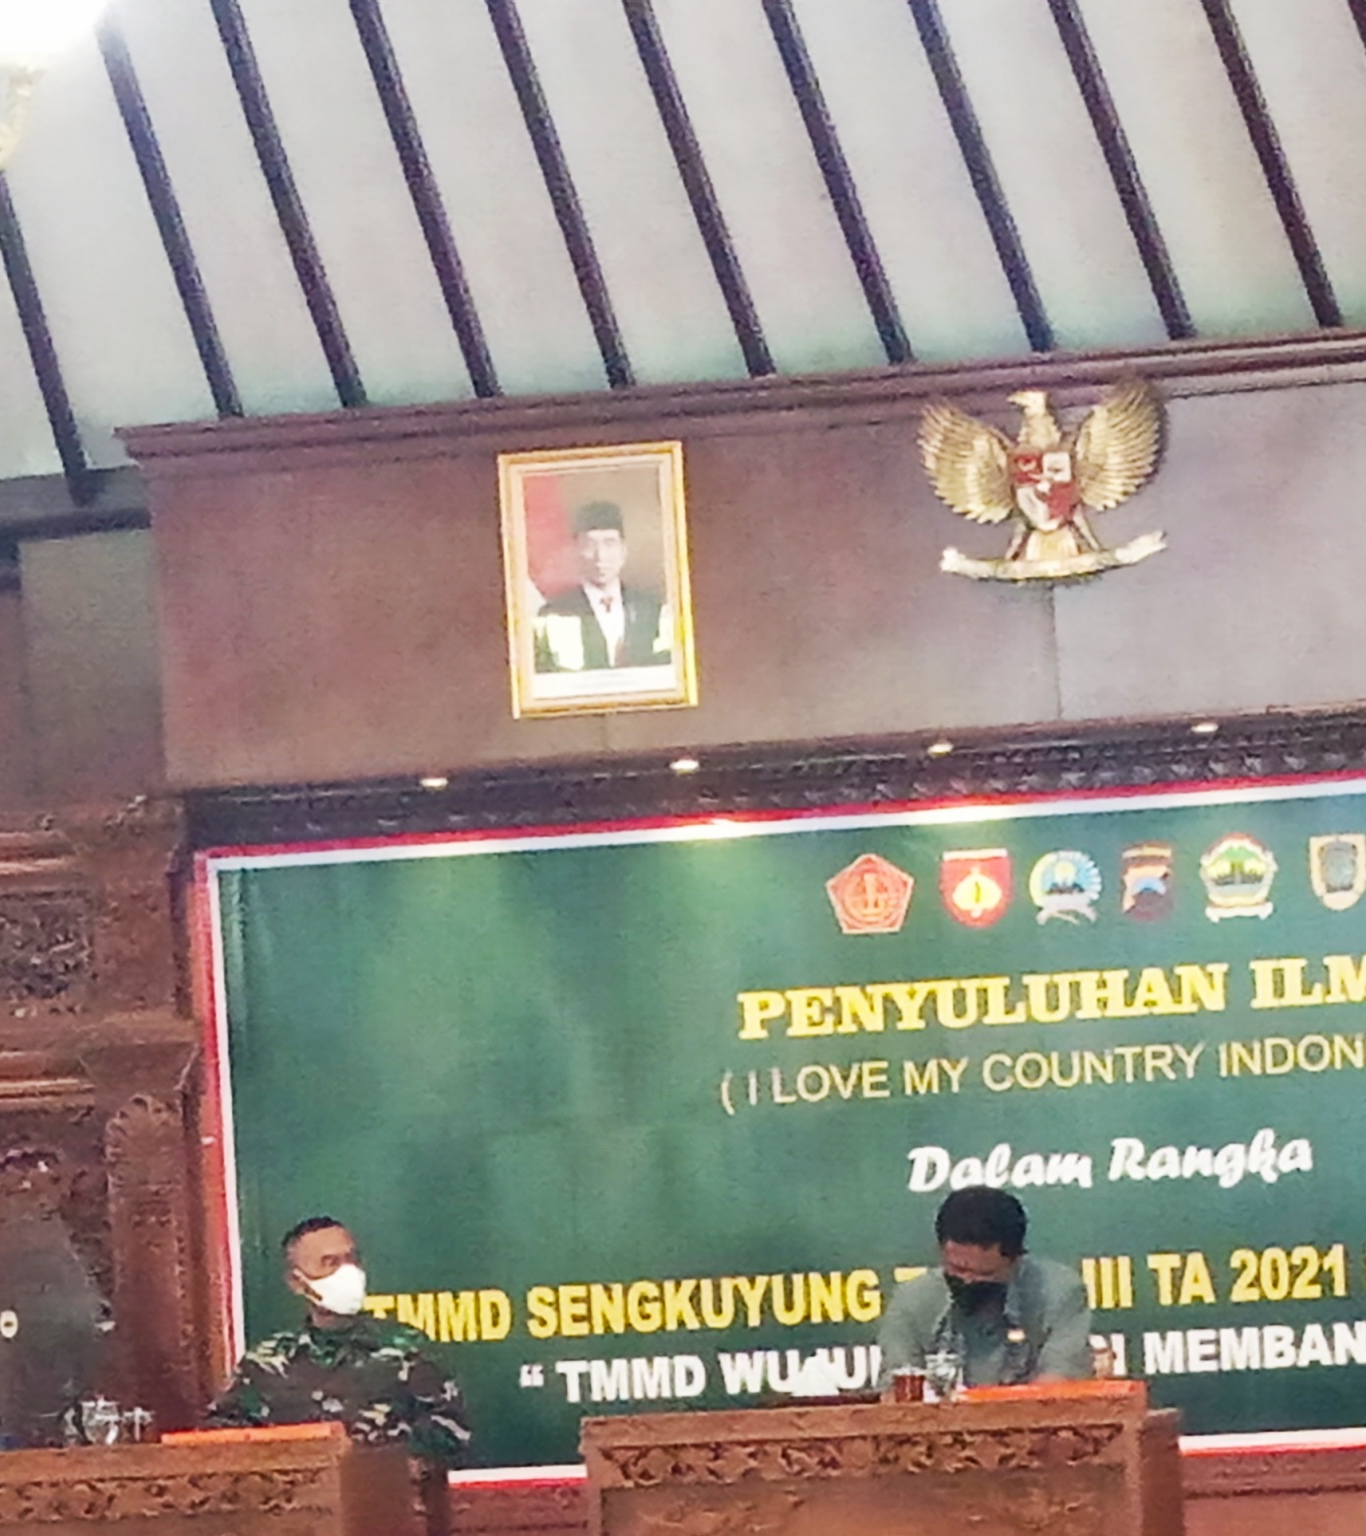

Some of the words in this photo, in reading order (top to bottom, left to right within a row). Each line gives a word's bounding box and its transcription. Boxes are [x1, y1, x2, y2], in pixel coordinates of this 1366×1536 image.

[738, 964, 1228, 1040] PENYULUHAN
[771, 1061, 891, 1103] LOVE
[904, 1057, 968, 1095] MY
[983, 1042, 1206, 1091] COUNTRY
[908, 1143, 1093, 1192] Dalam
[1108, 1128, 1314, 1189] Rangka
[526, 1269, 882, 1339] SENGKUYUNG
[1147, 1251, 1217, 1307] TA
[1229, 1245, 1347, 1303] 2021
[555, 1355, 706, 1403] TMMD
